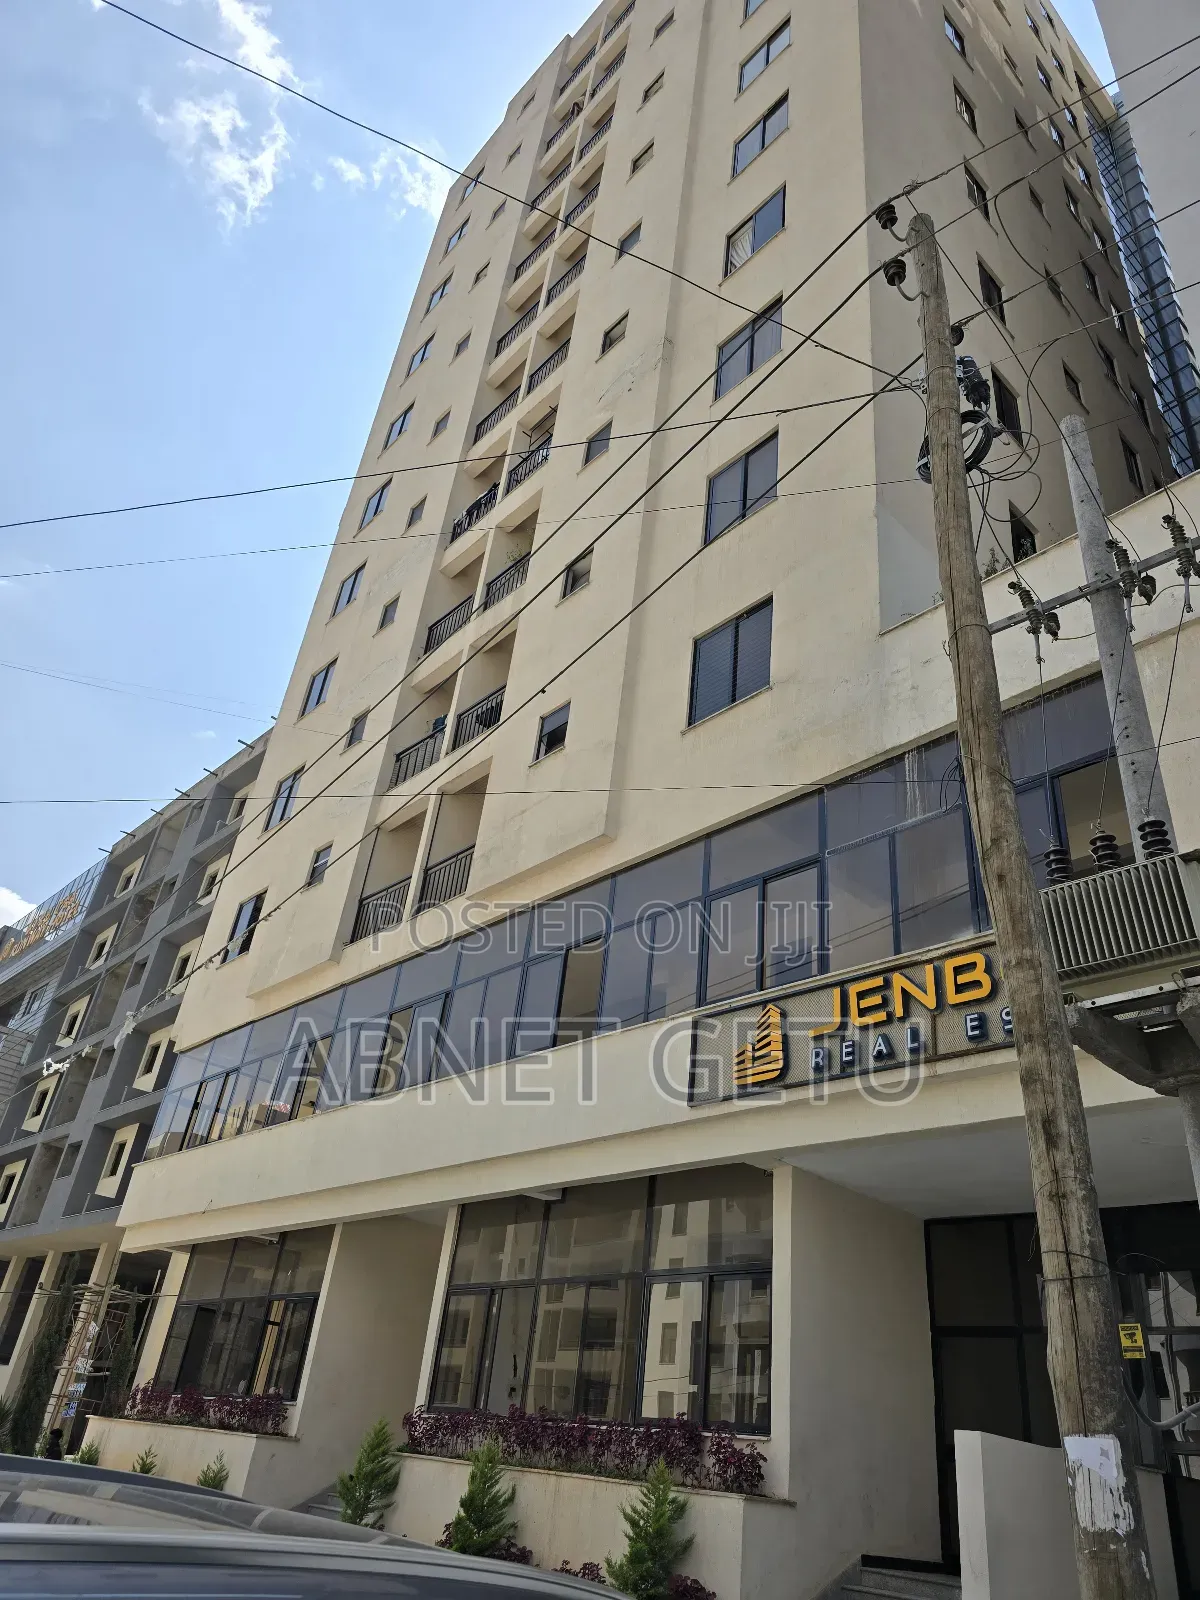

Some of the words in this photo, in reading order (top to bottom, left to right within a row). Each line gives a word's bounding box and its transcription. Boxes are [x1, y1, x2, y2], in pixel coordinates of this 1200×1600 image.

[808, 952, 1004, 1038] JENB
[811, 1027, 920, 1069] REAL
[965, 1007, 1014, 1036] ES
